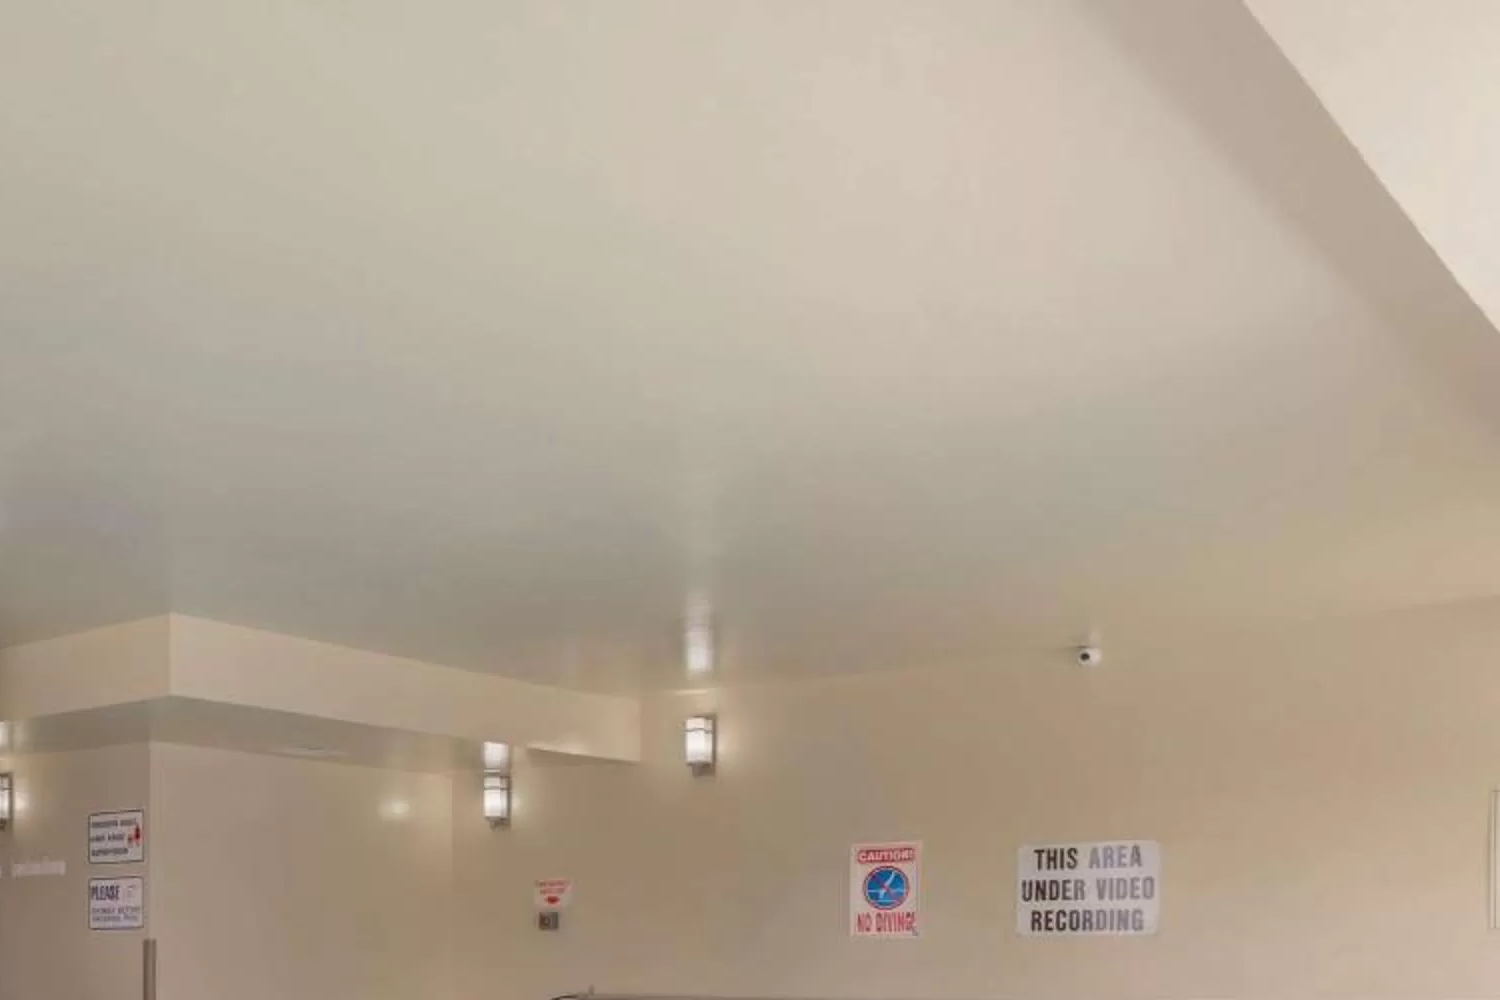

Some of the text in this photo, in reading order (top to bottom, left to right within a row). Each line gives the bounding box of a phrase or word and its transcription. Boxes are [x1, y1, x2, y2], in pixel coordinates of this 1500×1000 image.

[1033, 844, 1143, 871] THIS AREA
[1021, 876, 1156, 902] UNDER VIDEO
[1030, 908, 1145, 932] RECORDING
